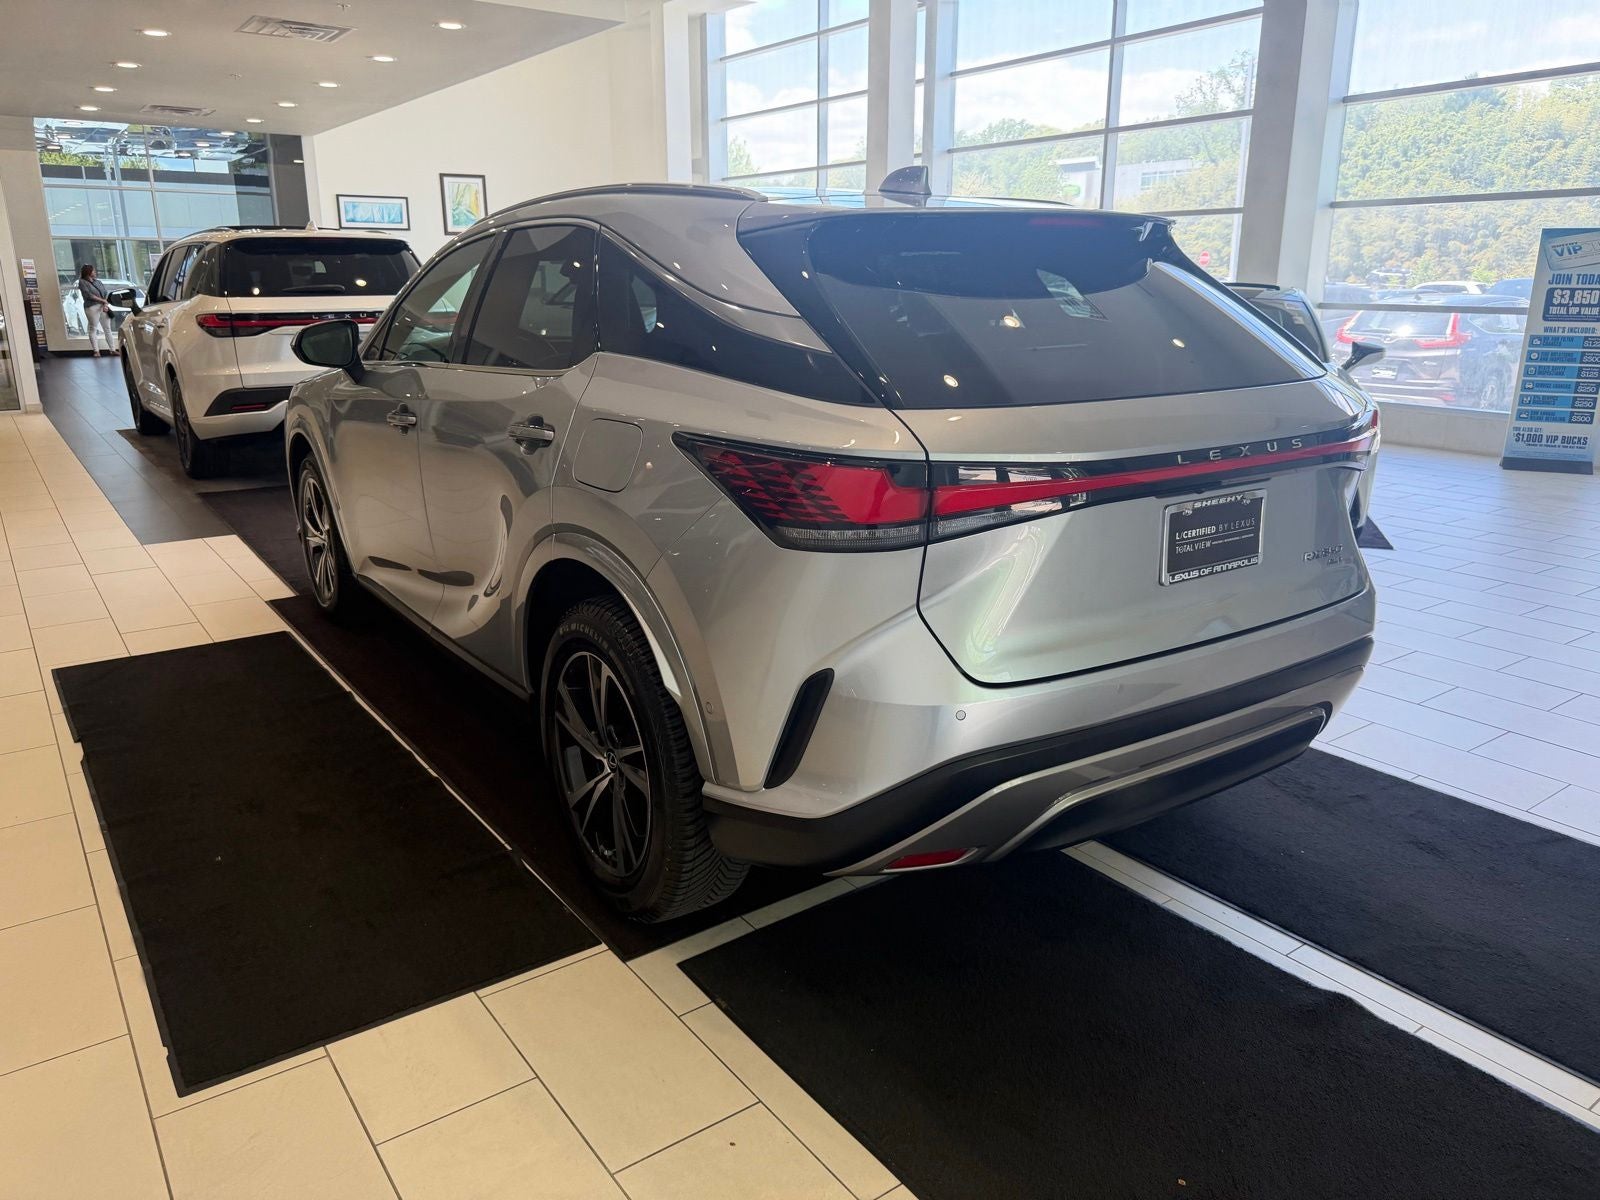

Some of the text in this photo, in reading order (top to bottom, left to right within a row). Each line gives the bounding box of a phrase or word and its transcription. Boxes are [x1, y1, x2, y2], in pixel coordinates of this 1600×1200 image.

[1553, 244, 1582, 257] VIP
[1548, 273, 1573, 285] JOIN
[1553, 289, 1600, 306] $3,850
[1549, 306, 1600, 315] TOTAL VIP VALUE
[1515, 432, 1588, 445] $1,000 VIP BUCKS
[1177, 438, 1303, 465] LEXUS
[1193, 494, 1244, 508] SHEEHY
[1218, 524, 1229, 532] BY
[1230, 517, 1255, 530] LEXUS
[1194, 540, 1212, 550] VIEW
[1169, 556, 1258, 583] LEXUS OF ANNAPOLIS
